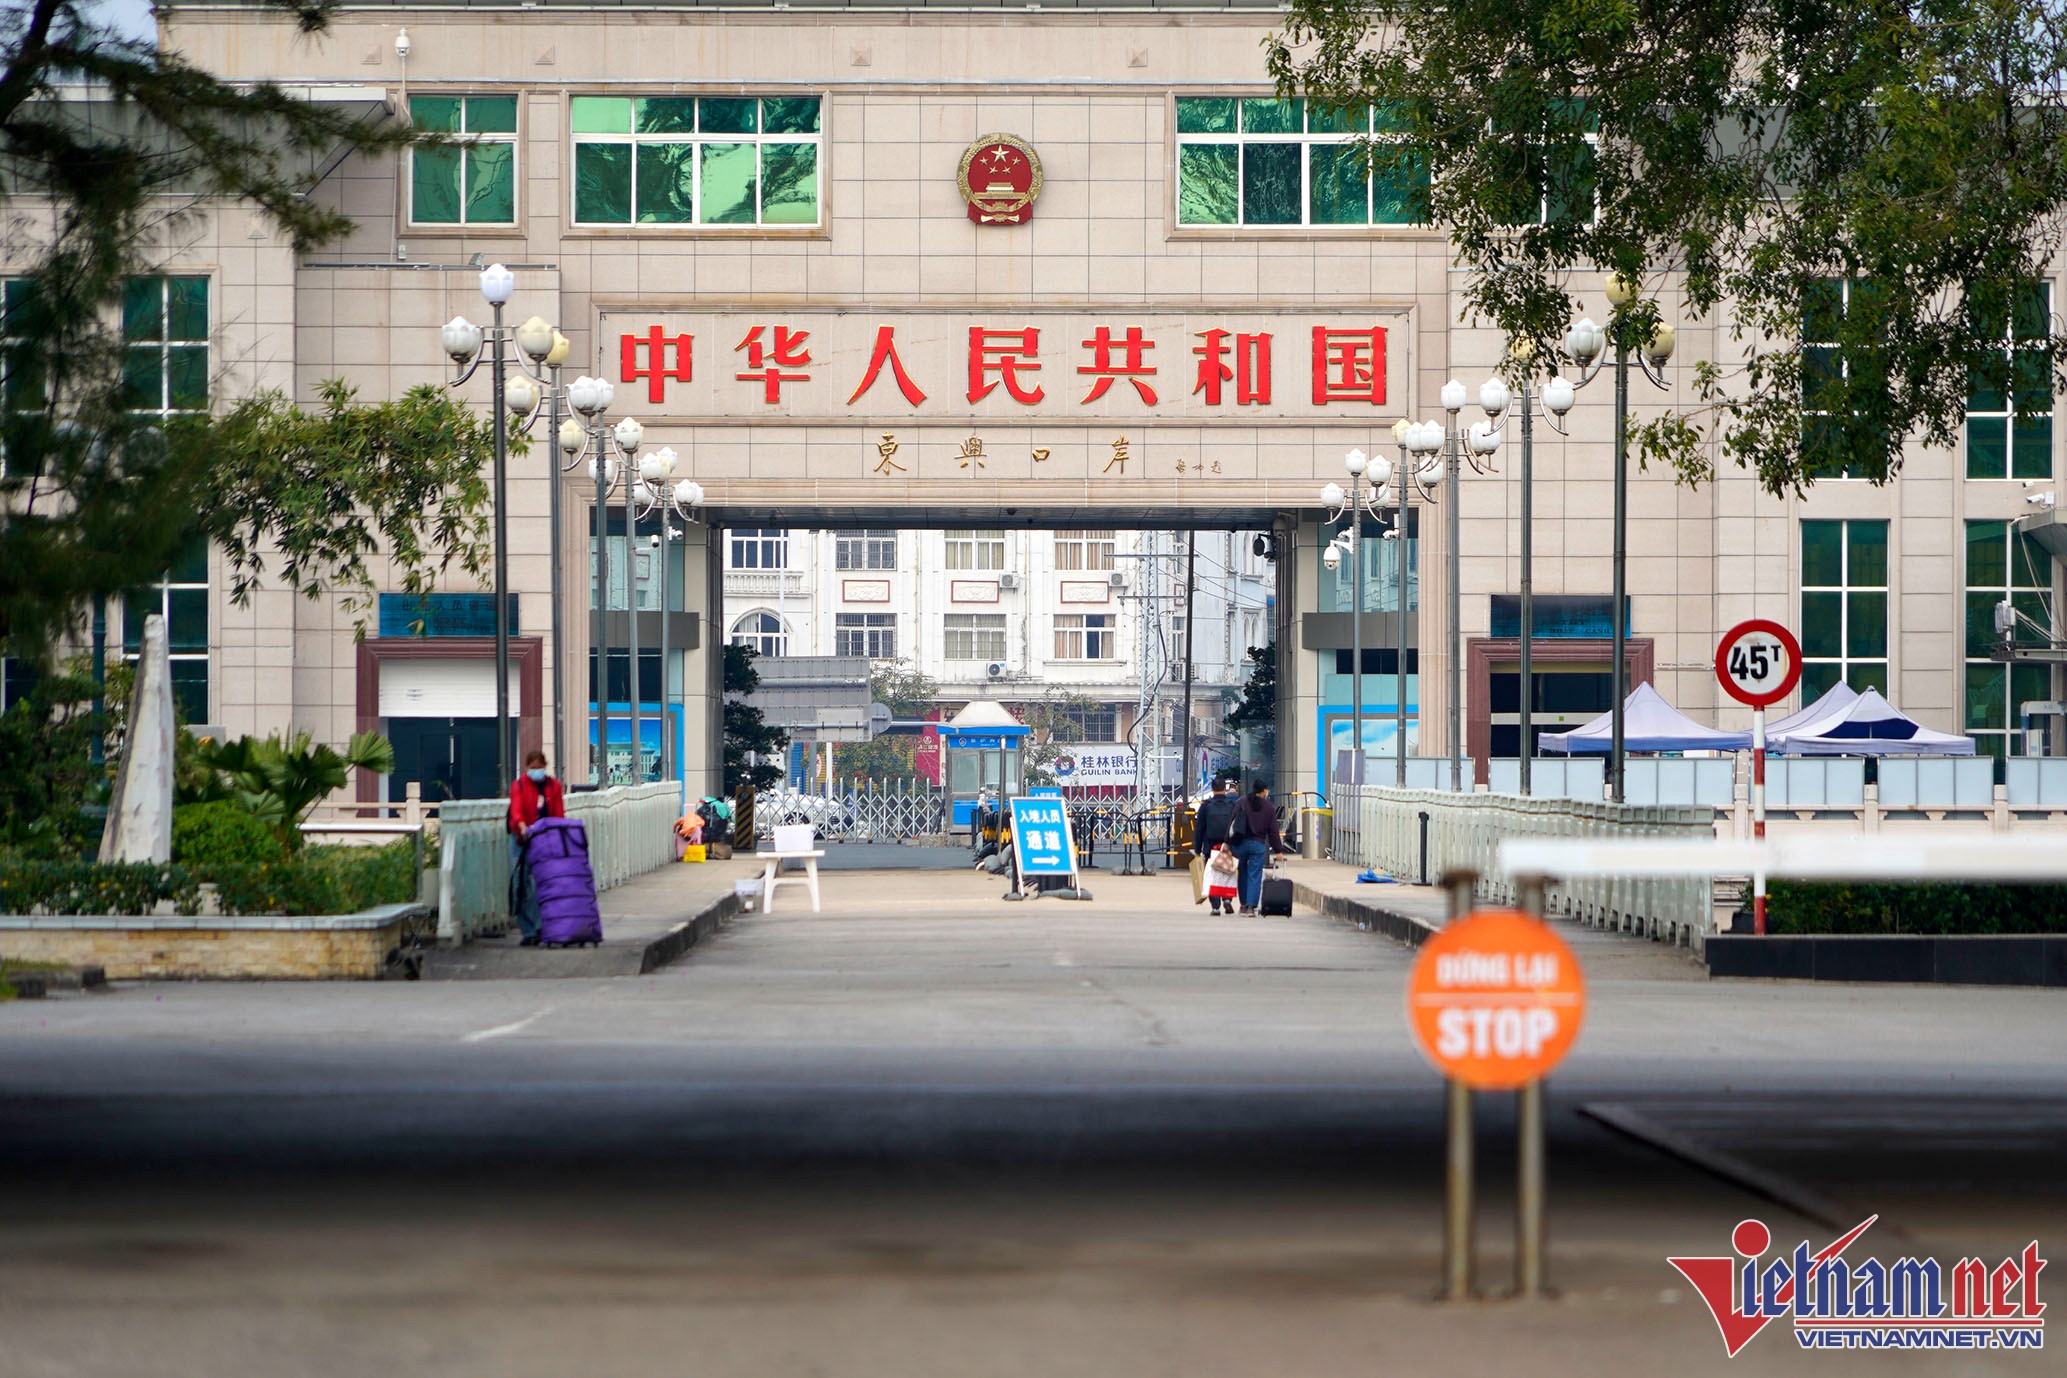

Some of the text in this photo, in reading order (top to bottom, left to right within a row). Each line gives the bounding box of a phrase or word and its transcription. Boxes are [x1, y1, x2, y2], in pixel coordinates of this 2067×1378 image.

[620, 324, 1388, 407] 中华人民共和国
[1081, 755, 1137, 768] 桂林银行
[1020, 809, 1061, 824] 入境人员
[1026, 830, 1061, 850] 通道
[1437, 1008, 1559, 1059] STOP
